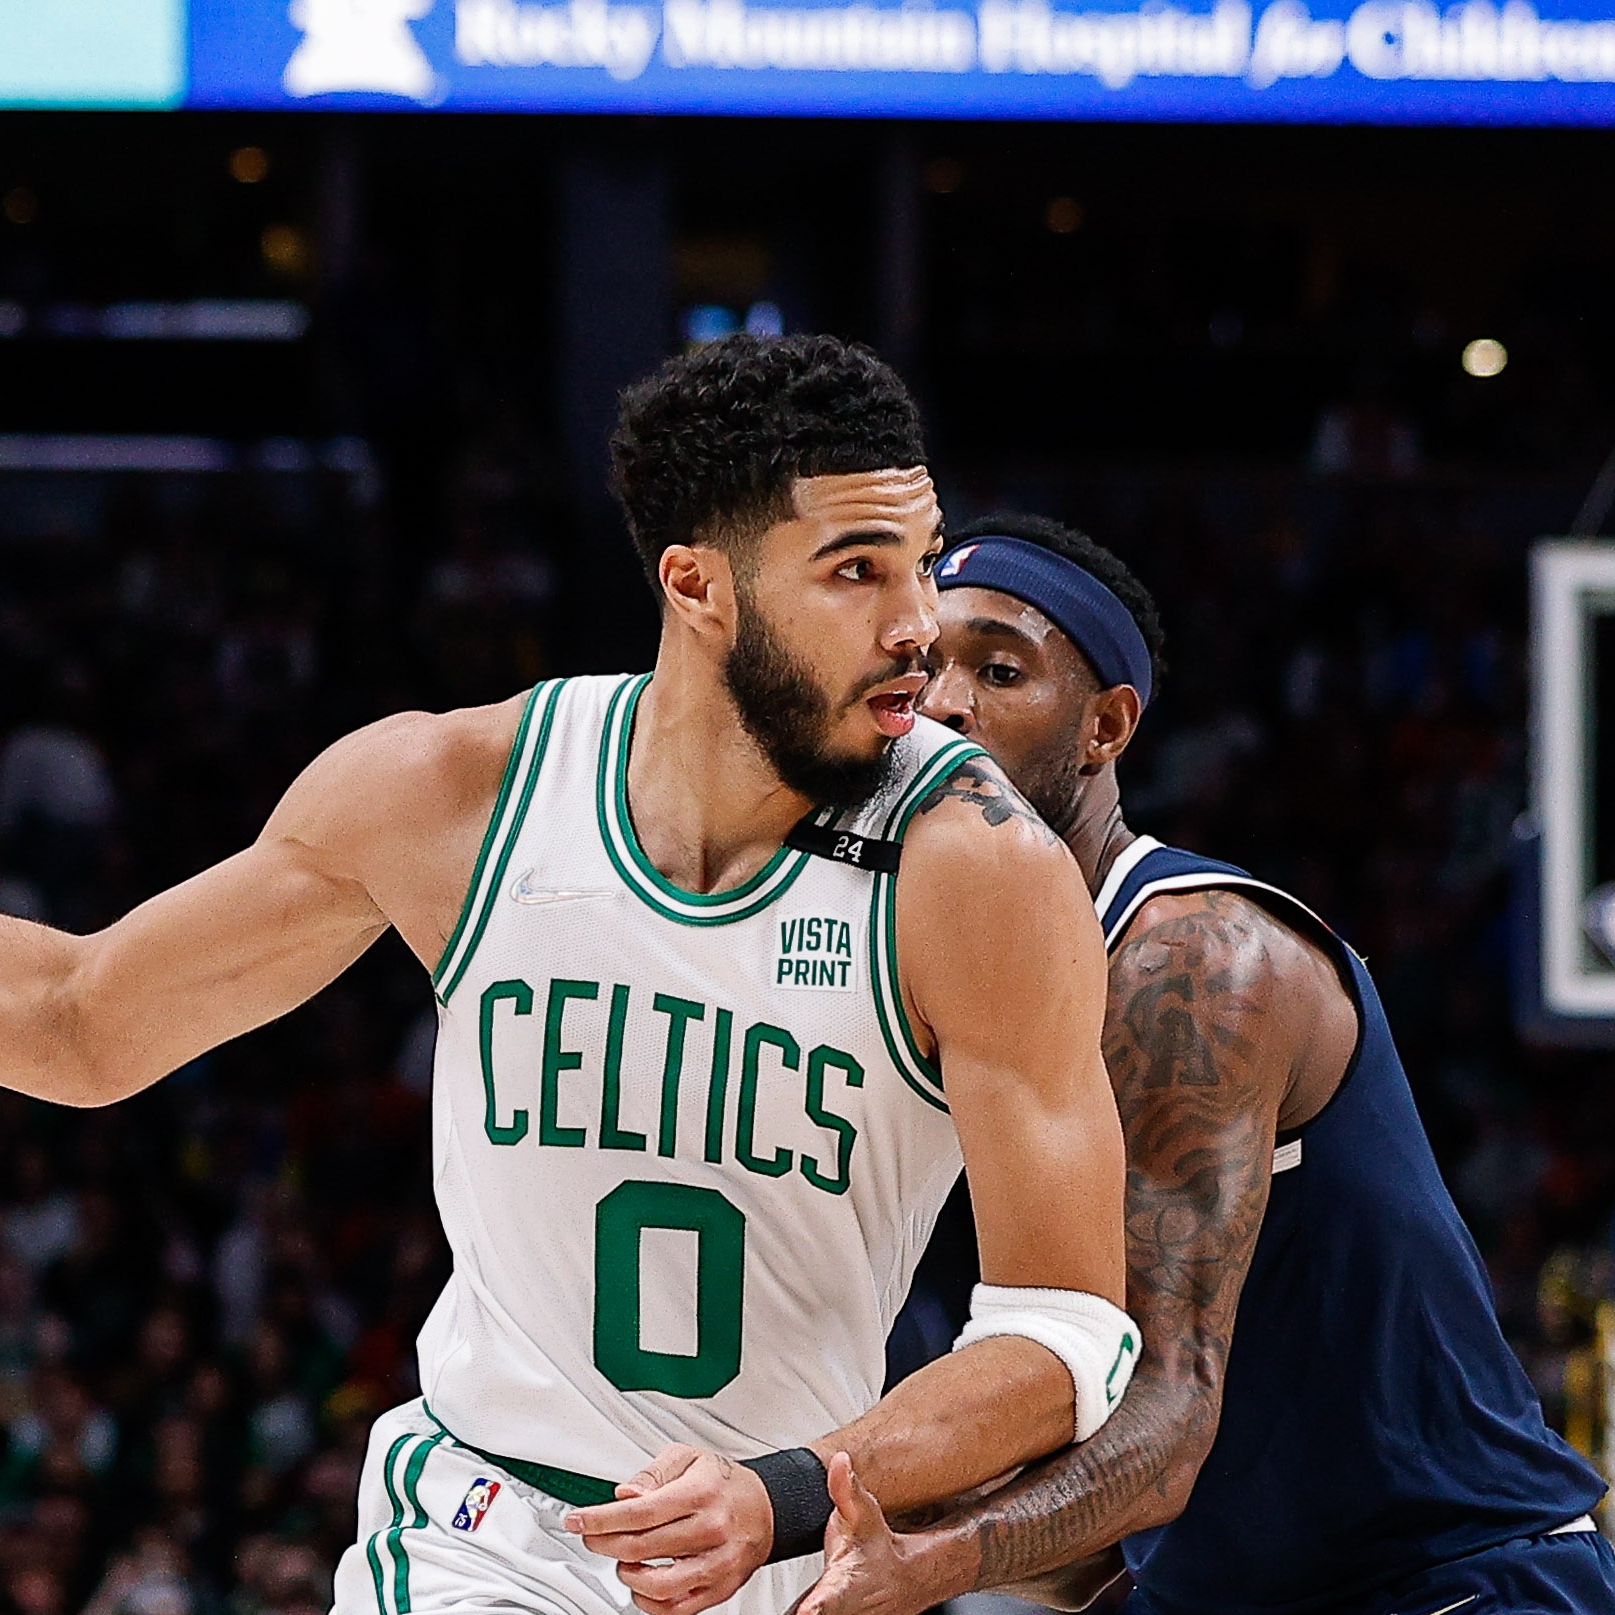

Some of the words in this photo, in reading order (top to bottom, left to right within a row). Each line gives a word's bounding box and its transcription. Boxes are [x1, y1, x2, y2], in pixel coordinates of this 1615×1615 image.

[832, 835, 864, 863] 24
[781, 917, 852, 958] VISTA
[776, 958, 852, 987] PRINT
[479, 978, 865, 1196] CELTICS
[593, 1179, 747, 1400] 0
